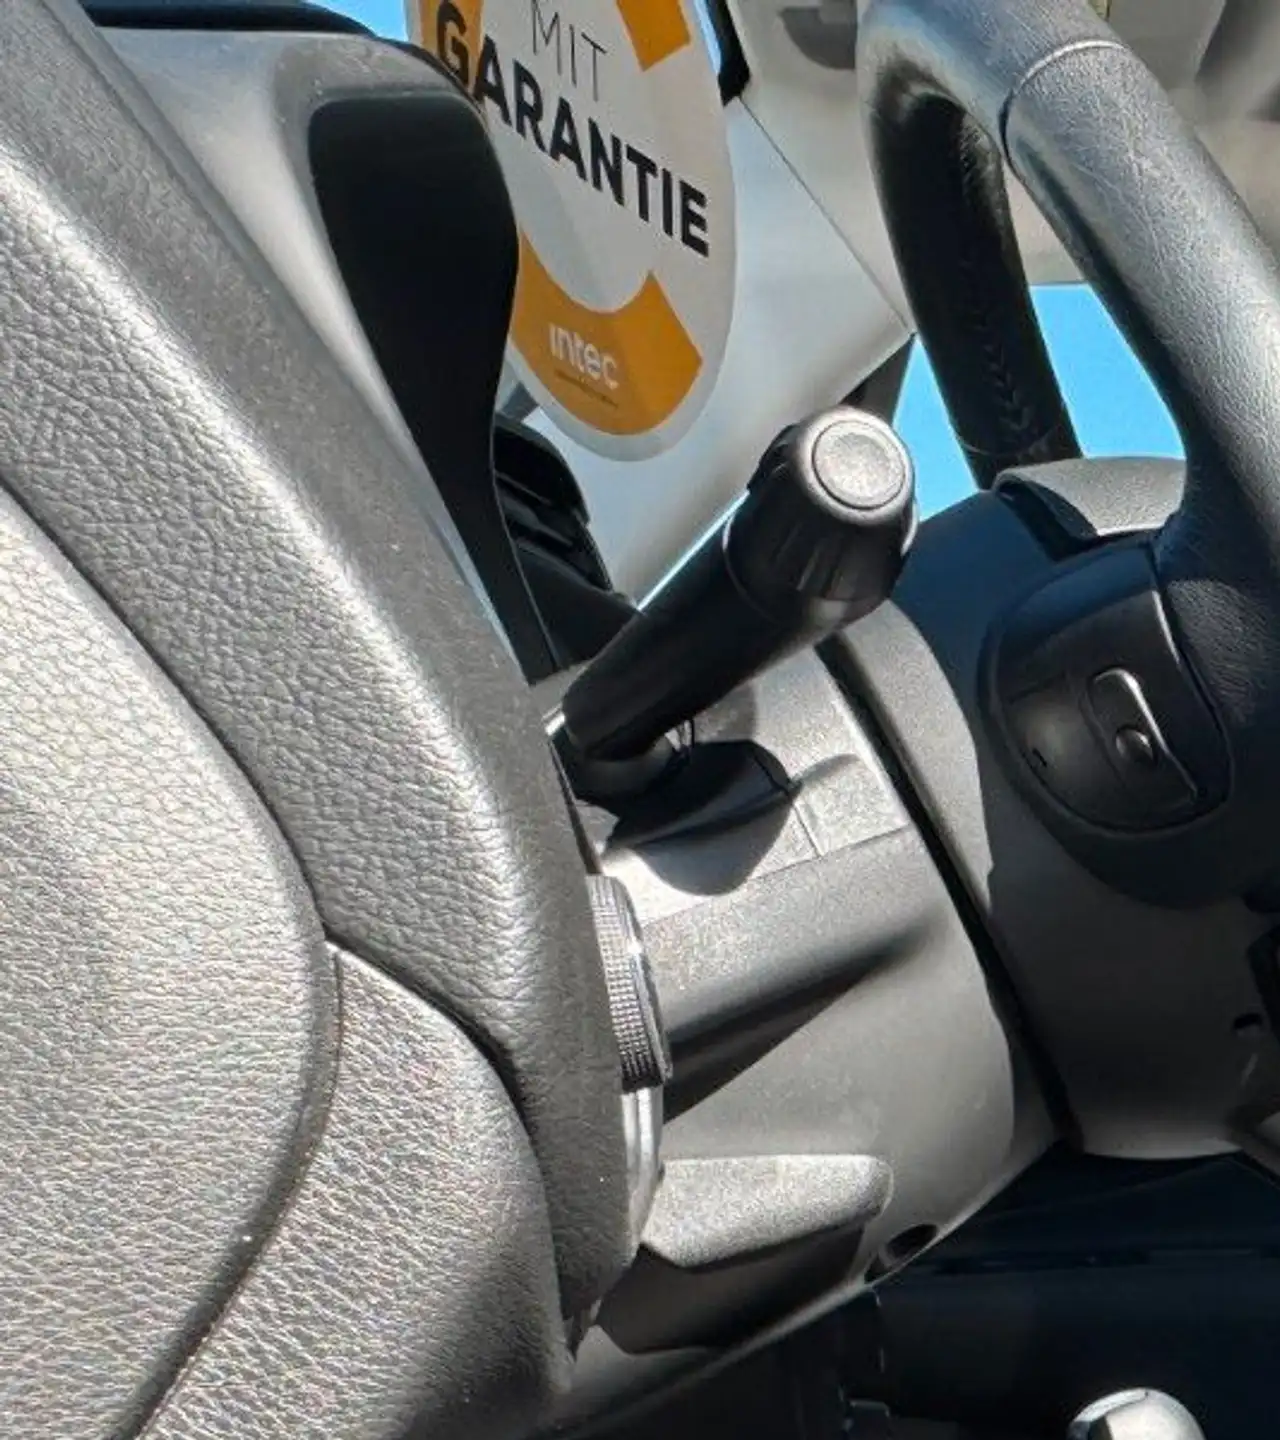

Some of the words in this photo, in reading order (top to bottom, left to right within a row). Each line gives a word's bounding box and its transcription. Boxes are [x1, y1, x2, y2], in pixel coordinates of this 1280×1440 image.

[531, 0, 607, 102] MIT
[436, 0, 710, 258] GARANTIE
[548, 322, 619, 390] intec
